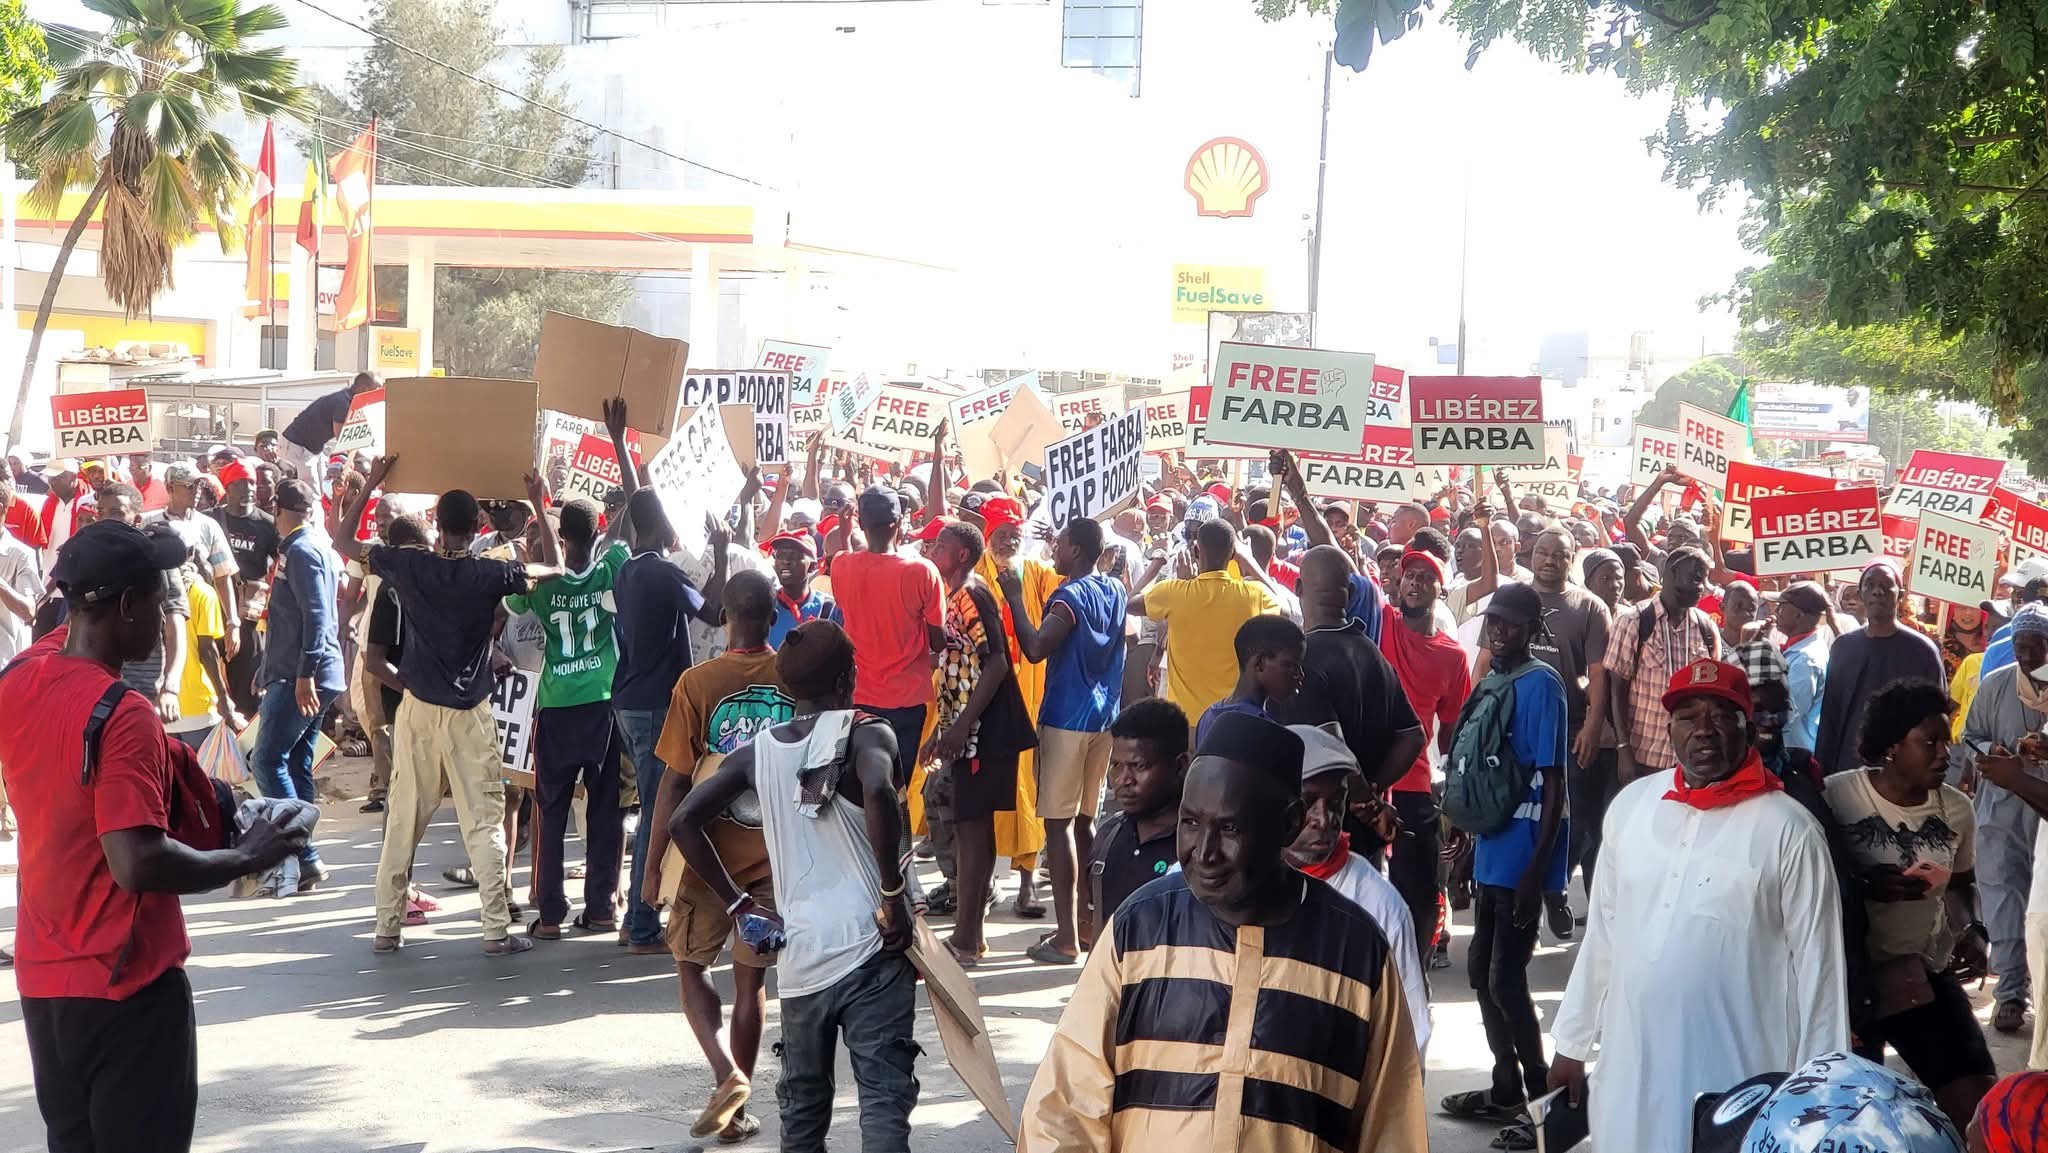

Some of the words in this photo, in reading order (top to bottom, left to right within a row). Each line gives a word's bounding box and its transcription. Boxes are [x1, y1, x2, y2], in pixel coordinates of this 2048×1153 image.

[1177, 271, 1210, 284] Shell
[1177, 286, 1264, 305] FuelSave
[380, 344, 413, 358] FuelSave
[763, 351, 806, 372] FREE
[1228, 362, 1321, 395] FREE
[57, 404, 147, 427] LIBÉREZ
[877, 396, 929, 418] FREE
[960, 389, 1012, 419] FREE
[1060, 398, 1102, 417] FREE
[1146, 404, 1177, 422] REE
[1221, 395, 1350, 432] FARBA
[1418, 394, 1539, 420] LIBÉREZ
[61, 427, 144, 449] FARBA
[756, 423, 785, 461] RBA
[1421, 427, 1534, 450] FARBA
[1686, 418, 1725, 450] FREE
[1049, 433, 1096, 489] FREE
[1101, 408, 1143, 467] FARBA
[1641, 437, 1677, 459] FRE
[1684, 441, 1727, 474] FARB
[576, 451, 622, 483] LIBÉR
[1306, 463, 1406, 490] FARBA
[1904, 467, 1994, 493] LIBÉREZ
[1051, 476, 1097, 530] CAP
[1102, 451, 1139, 508] PODOR
[1894, 488, 1974, 515] FARBA
[1760, 507, 1877, 536] LIBÉREZ
[1763, 534, 1873, 563] FARBA
[1923, 527, 1972, 560] FREE
[1919, 555, 1985, 592] FARBA
[550, 594, 567, 607] ASC
[569, 593, 589, 608] GUYE
[550, 607, 600, 658] 11
[552, 655, 602, 676] MOUHAMED
[1690, 661, 1719, 685] B
[490, 673, 528, 714] AP
